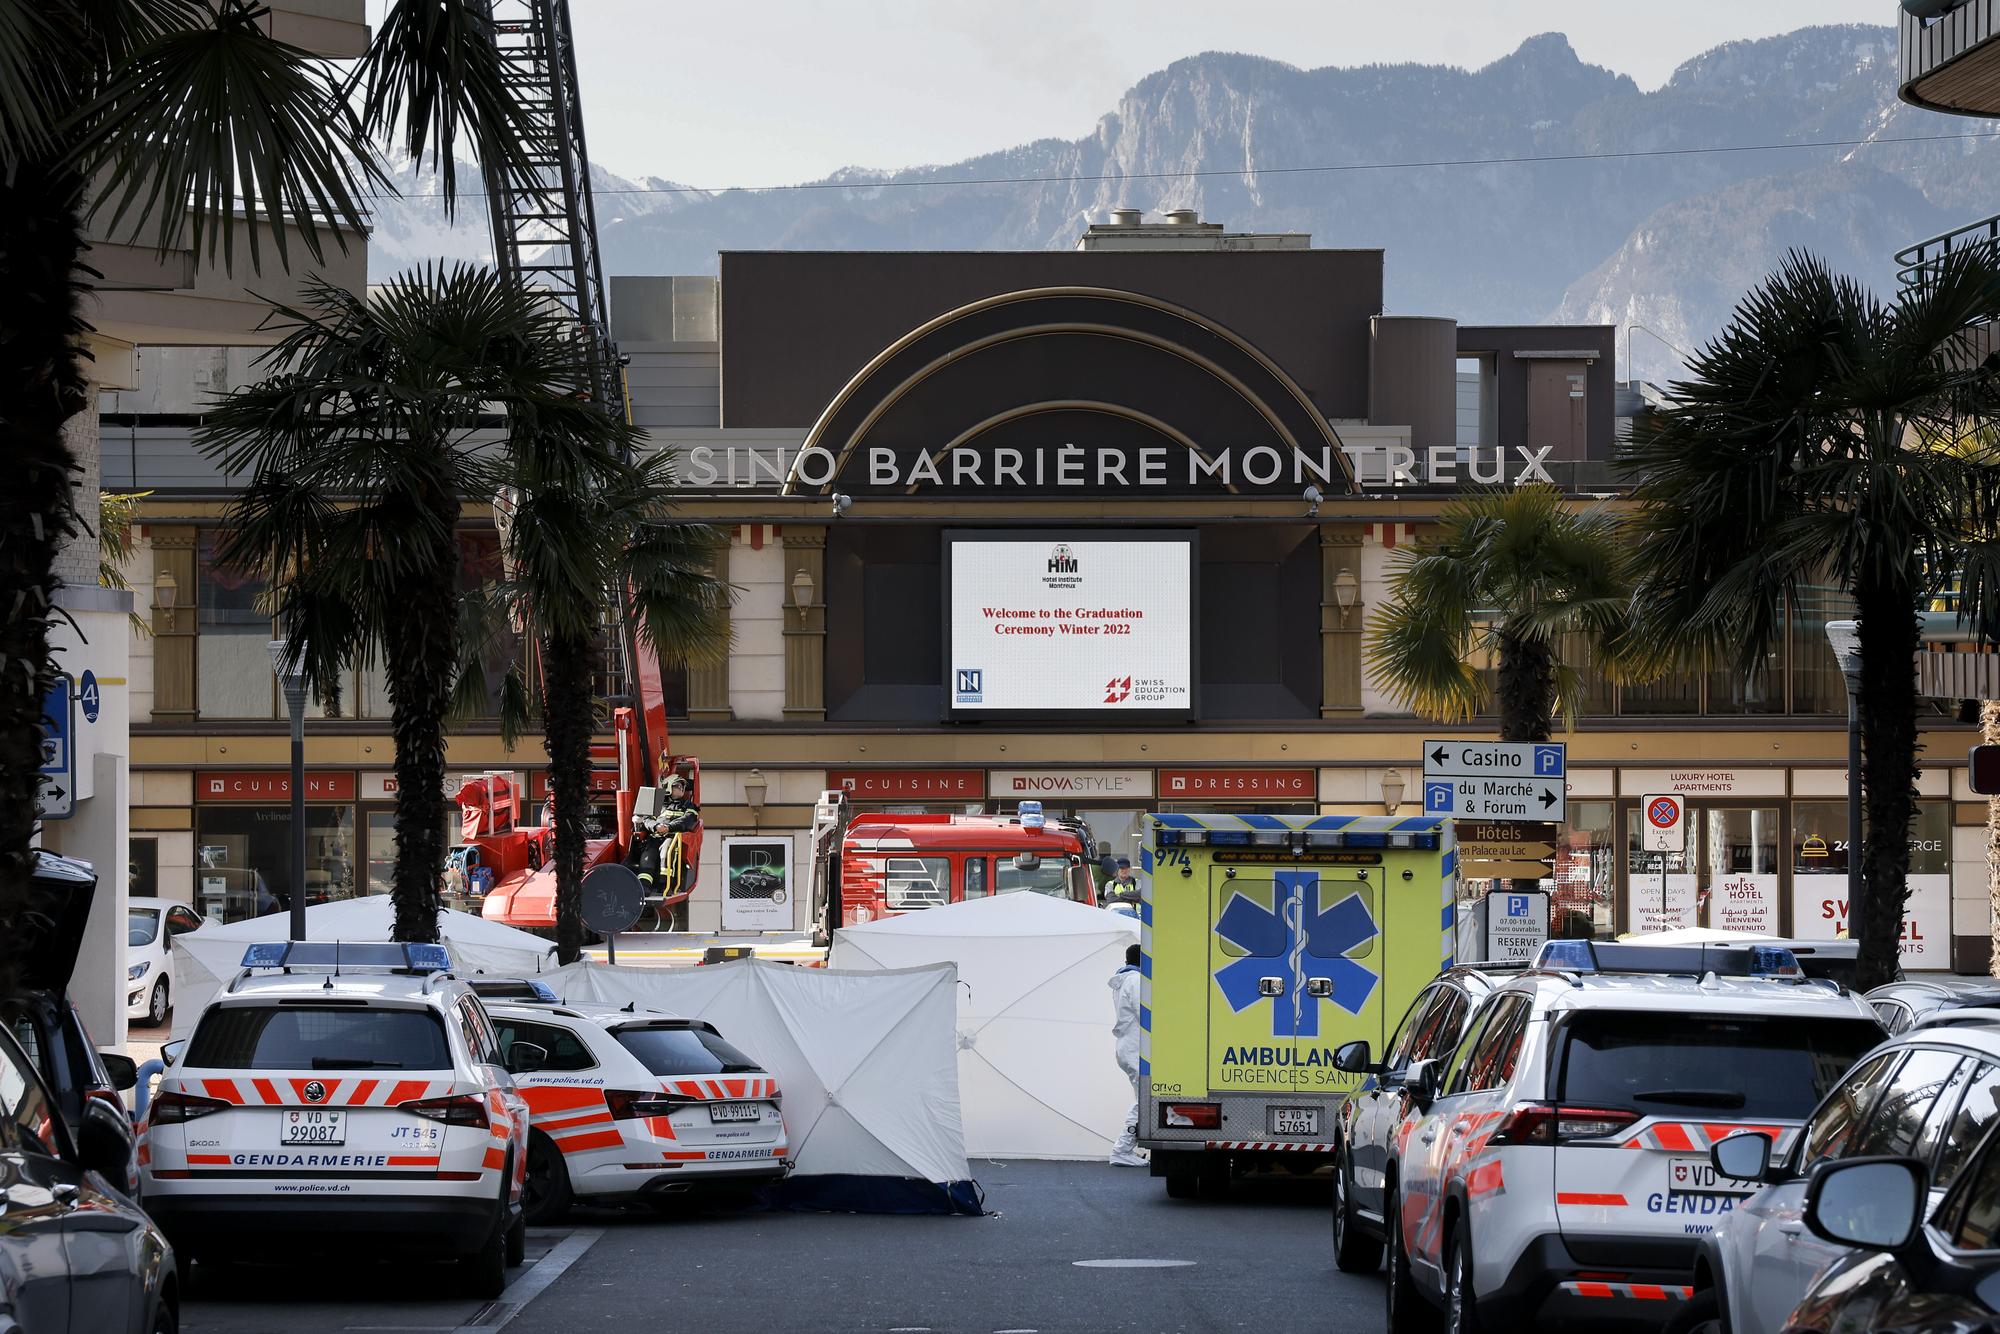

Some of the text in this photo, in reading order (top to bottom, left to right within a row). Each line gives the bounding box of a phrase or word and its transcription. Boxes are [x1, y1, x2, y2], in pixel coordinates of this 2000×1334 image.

[669, 443, 1554, 486] SINO BARRIÈRE MONTREUX
[982, 608, 1143, 618] Welcome to the Graduation
[994, 624, 1130, 637] Ceremony Winter 2022
[82, 684, 98, 706] 4
[1462, 749, 1522, 766] Casino
[234, 781, 335, 791] CUISNE
[865, 779, 964, 789] CUISINE
[1028, 777, 1123, 790] NOVASTYLE
[1195, 778, 1302, 788] DRESSING
[1459, 781, 1533, 796] du Marché
[1466, 800, 1526, 814] & Forum
[1476, 826, 1521, 840] Hôtels
[1472, 846, 1498, 855] Palace
[1512, 846, 1526, 855] Lac
[1154, 848, 1190, 866] 974
[1724, 880, 1755, 891] SWISS
[1498, 938, 1537, 946] RESERVE
[1508, 948, 1528, 956] TAXI
[1222, 1046, 1336, 1067] AMBULAN
[529, 1076, 604, 1085] www.police.vd.ch
[1221, 1069, 1309, 1084] URGENCES
[307, 1112, 322, 1124] VD
[1291, 1110, 1302, 1119] VD
[1280, 1121, 1312, 1132] 57651
[290, 1126, 336, 1140] 99087
[391, 1128, 437, 1139] JT 545
[234, 1154, 386, 1166] GENDARMERIE
[708, 1149, 772, 1159] GENDARMERIE
[1692, 1166, 1716, 1186] VD
